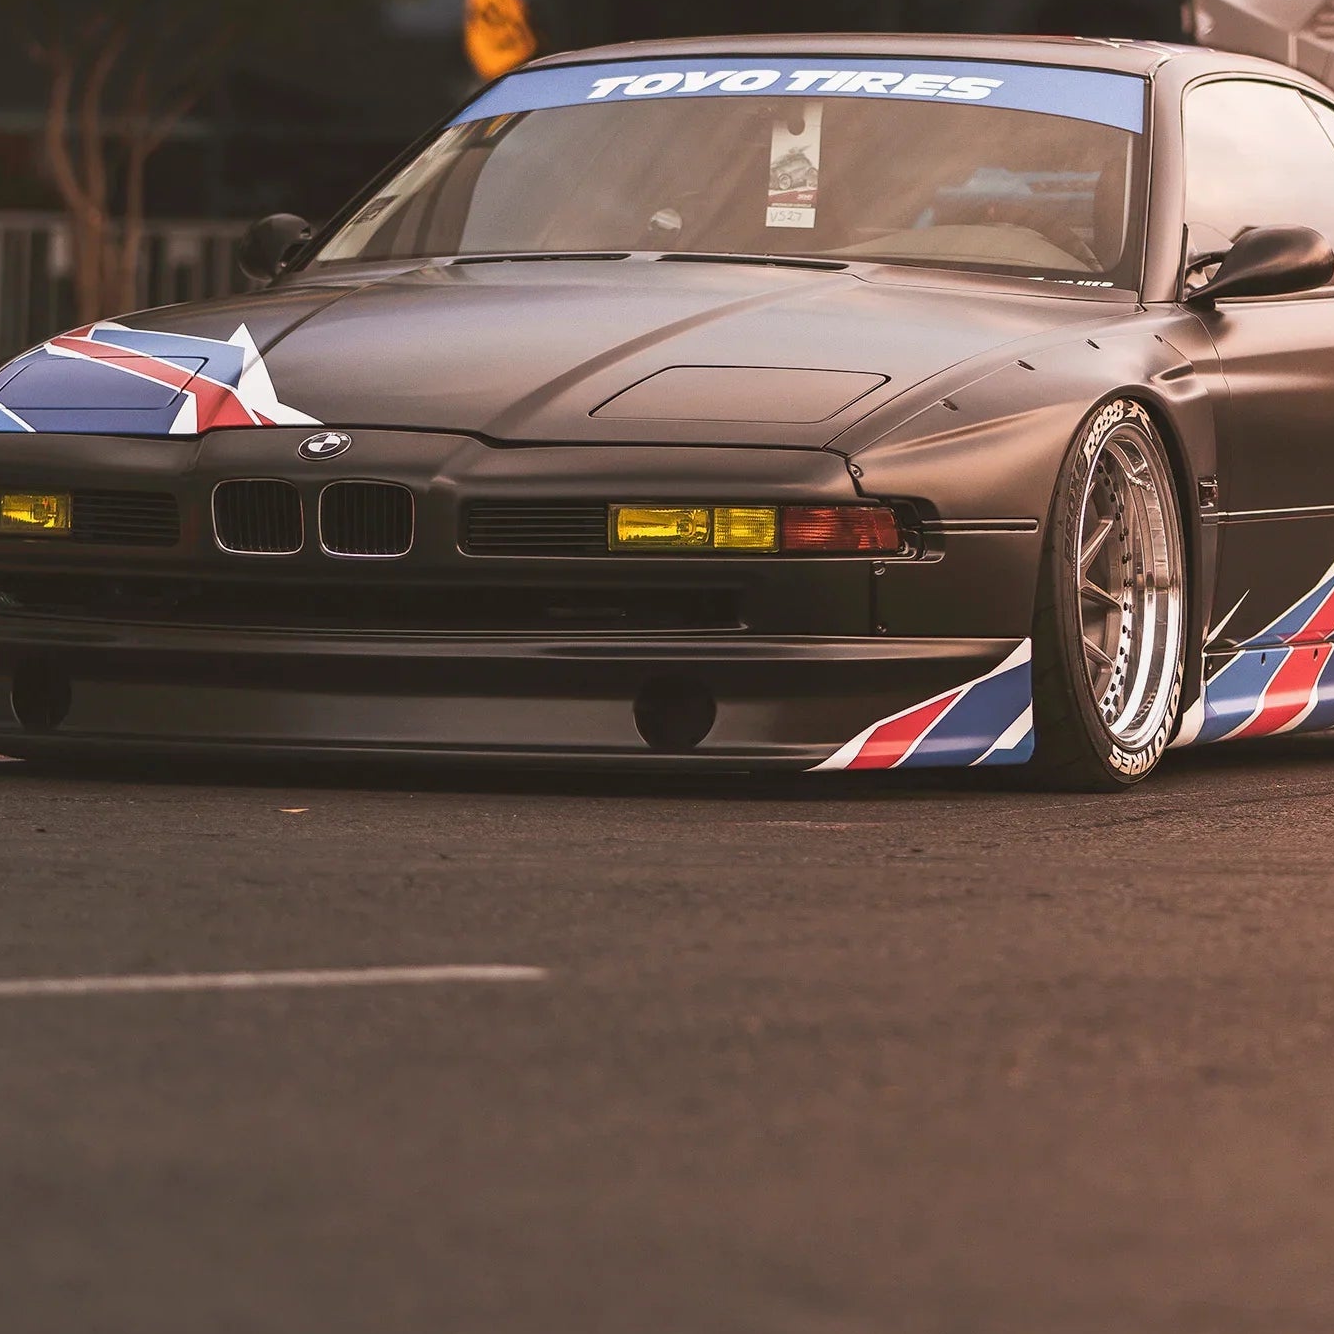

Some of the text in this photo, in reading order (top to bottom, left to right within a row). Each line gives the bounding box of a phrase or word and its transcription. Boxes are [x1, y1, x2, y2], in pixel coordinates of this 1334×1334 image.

[586, 70, 1004, 100] TOYO TIRES
[1108, 744, 1156, 776] TIRES
